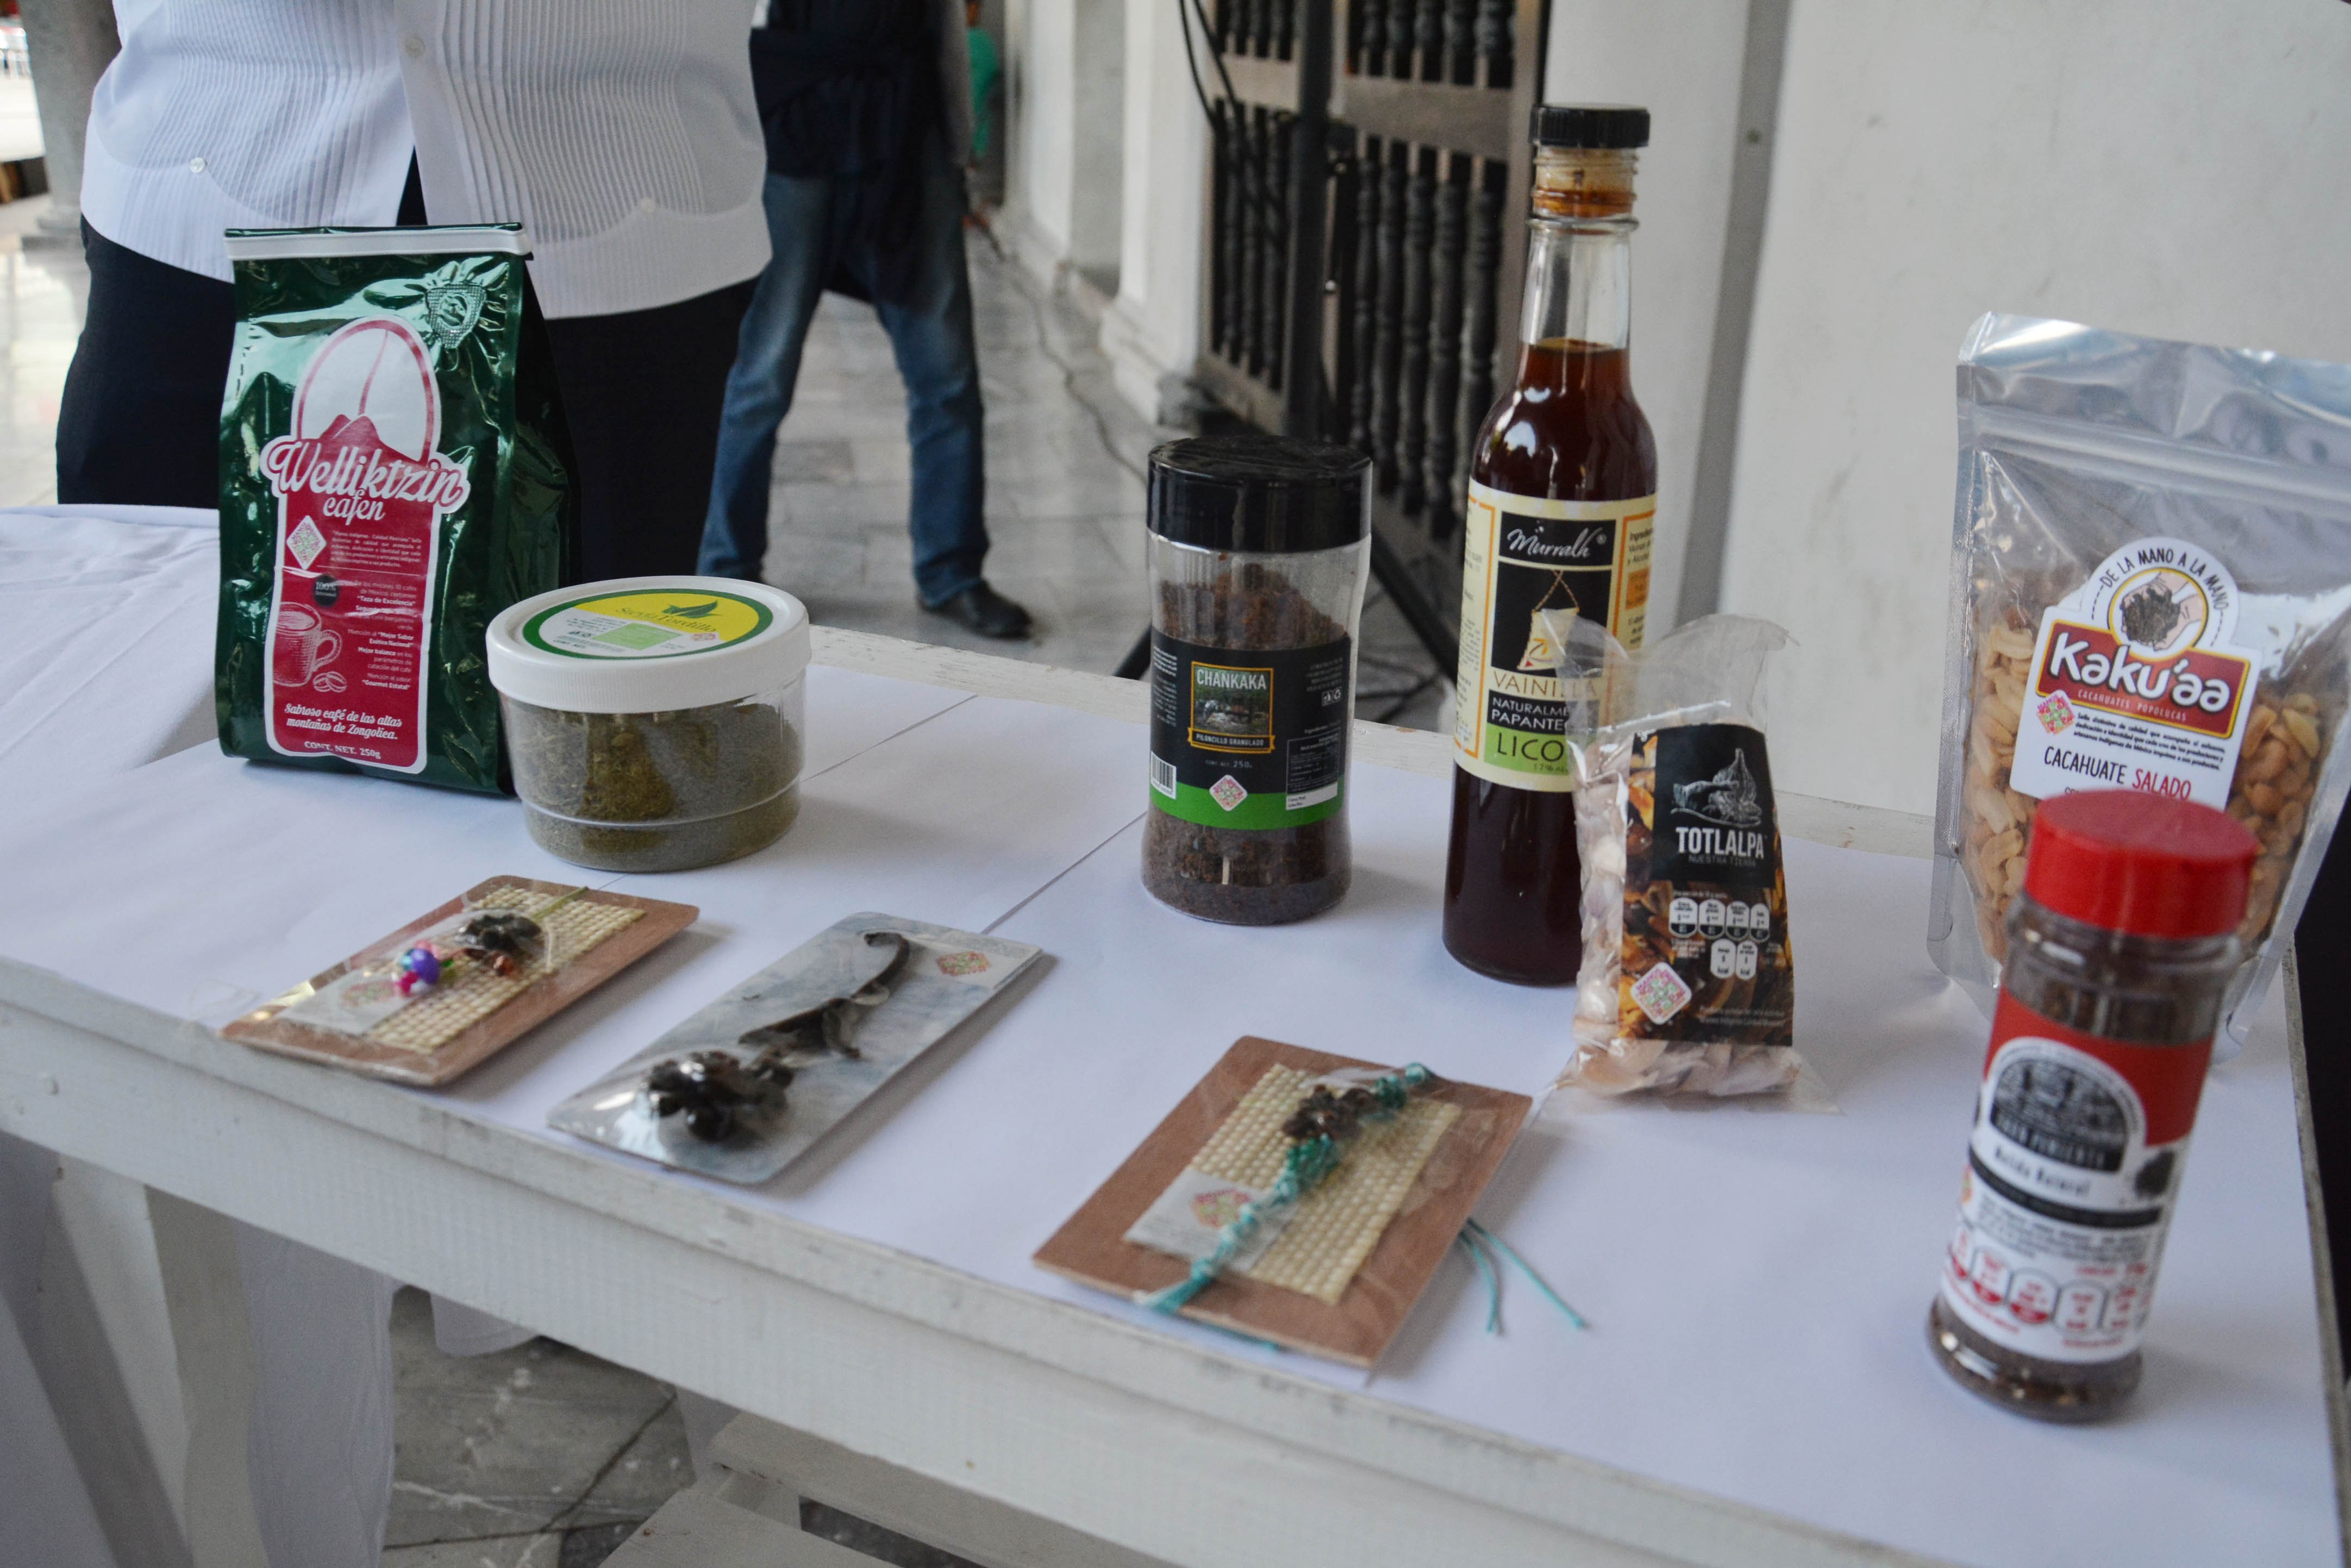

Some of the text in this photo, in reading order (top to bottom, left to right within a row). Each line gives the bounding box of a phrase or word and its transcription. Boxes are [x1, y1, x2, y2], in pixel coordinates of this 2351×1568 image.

[2099, 548, 2229, 610] DE LA MANO A LA MANO
[1197, 669, 1267, 690] CHANKAKA
[2078, 688, 2130, 710] CACAHUATES
[285, 703, 403, 727] Sabroso café de las altas
[286, 718, 332, 731] montañas
[333, 722, 346, 733] de
[1491, 708, 1568, 731] PAPANTE
[1196, 733, 1228, 745] PILONCILLO
[1498, 732, 1564, 762] LICO
[335, 745, 357, 754] NET.
[359, 748, 382, 760] 250g
[2044, 745, 2191, 801] CACAHUATE SALADO
[1675, 827, 1765, 859] TOTLALPA
